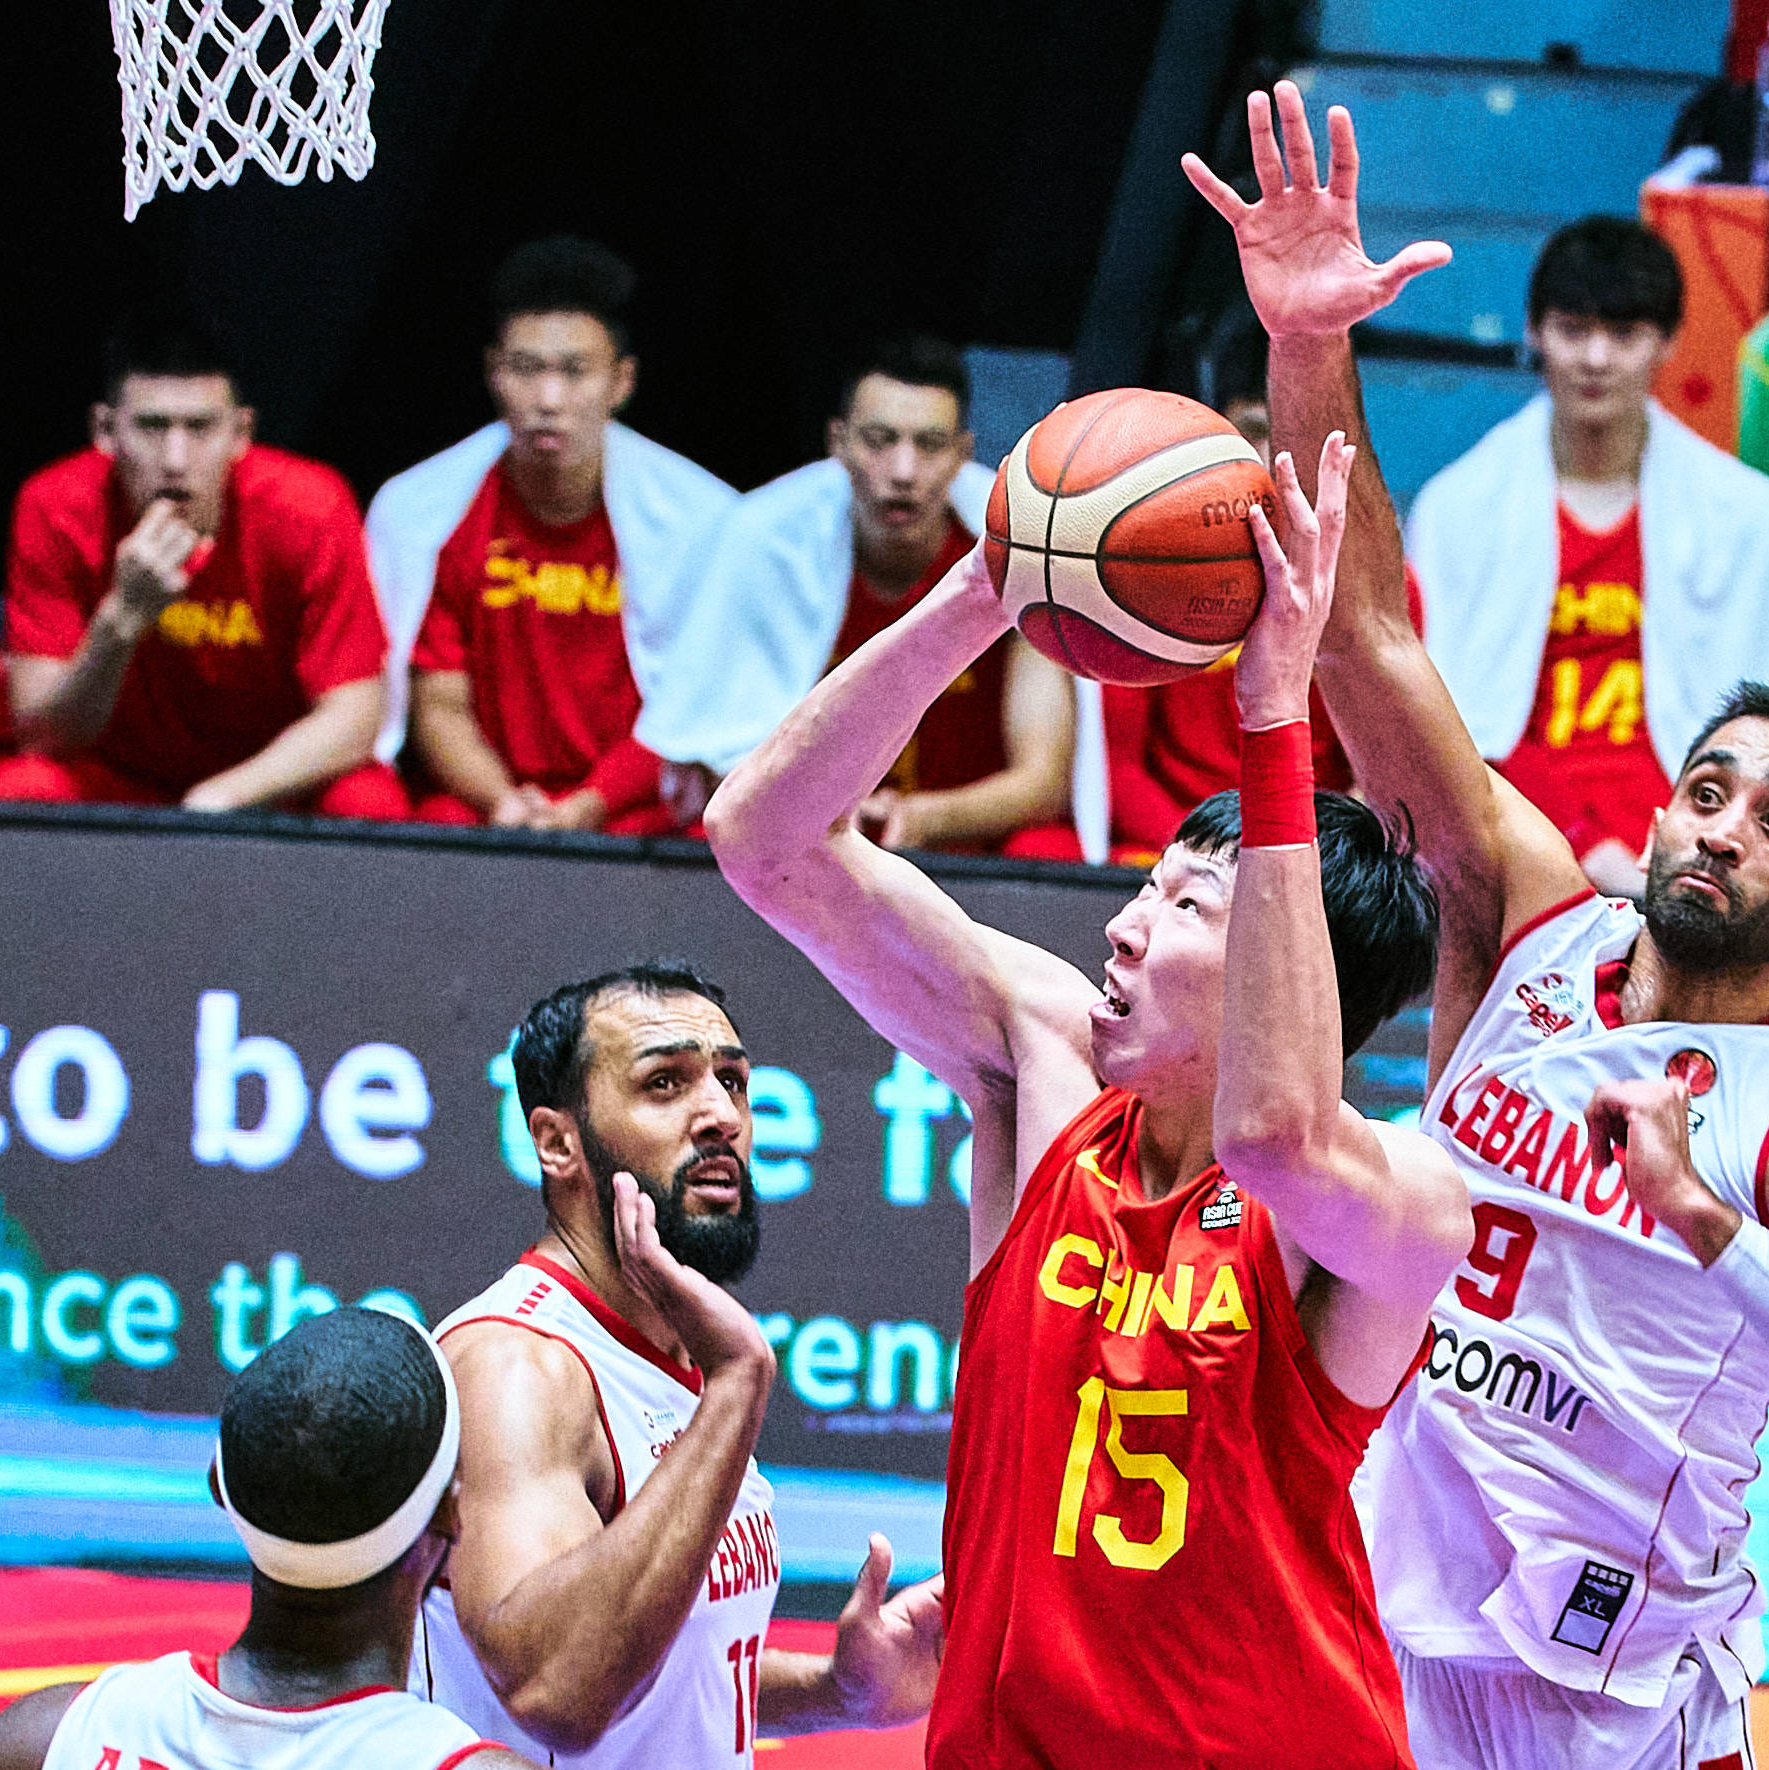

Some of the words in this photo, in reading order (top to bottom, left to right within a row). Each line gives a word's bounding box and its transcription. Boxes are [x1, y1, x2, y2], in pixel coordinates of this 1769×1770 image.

[1545, 657, 1643, 748] 14
[190, 990, 433, 1180] be
[1038, 1232, 1252, 1337] CHINA
[1455, 1202, 1538, 1322] 9
[1053, 1376, 1189, 1571] 15
[1577, 1594, 1607, 1618] XL
